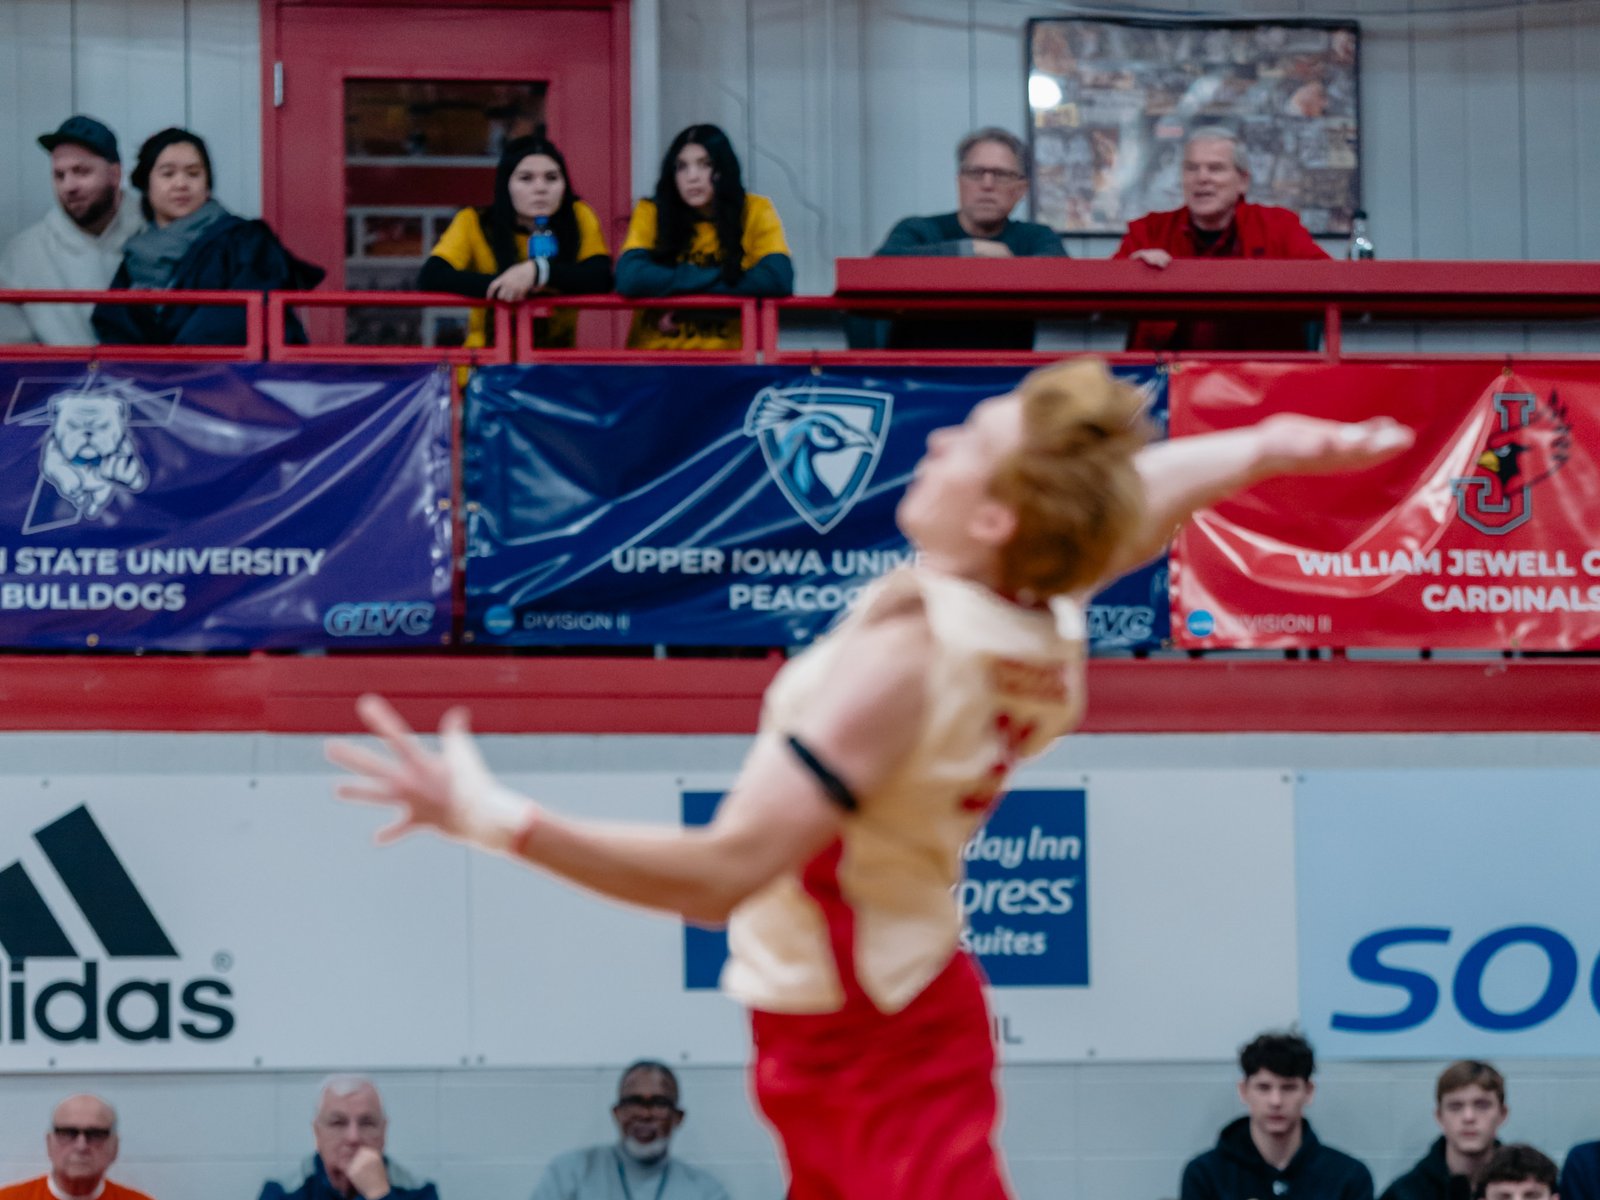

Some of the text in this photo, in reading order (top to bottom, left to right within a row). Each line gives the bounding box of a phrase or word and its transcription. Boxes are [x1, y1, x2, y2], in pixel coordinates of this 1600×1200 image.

[15, 548, 118, 575] STATE
[126, 548, 326, 576] UNIVERSITY
[612, 547, 723, 574] UPPER
[732, 548, 826, 575] IOWA
[1298, 550, 1441, 577] WILLIAM
[1447, 550, 1574, 577] JEWELL
[1, 583, 187, 612] BULLDOGS
[1422, 585, 1600, 613] CARDINALS
[324, 602, 435, 637] GLVC
[523, 612, 613, 631] DIVISION
[1027, 825, 1081, 861] Inn
[957, 878, 1074, 915] press
[1329, 924, 1600, 1034] SO
[0, 957, 235, 1042] idas
